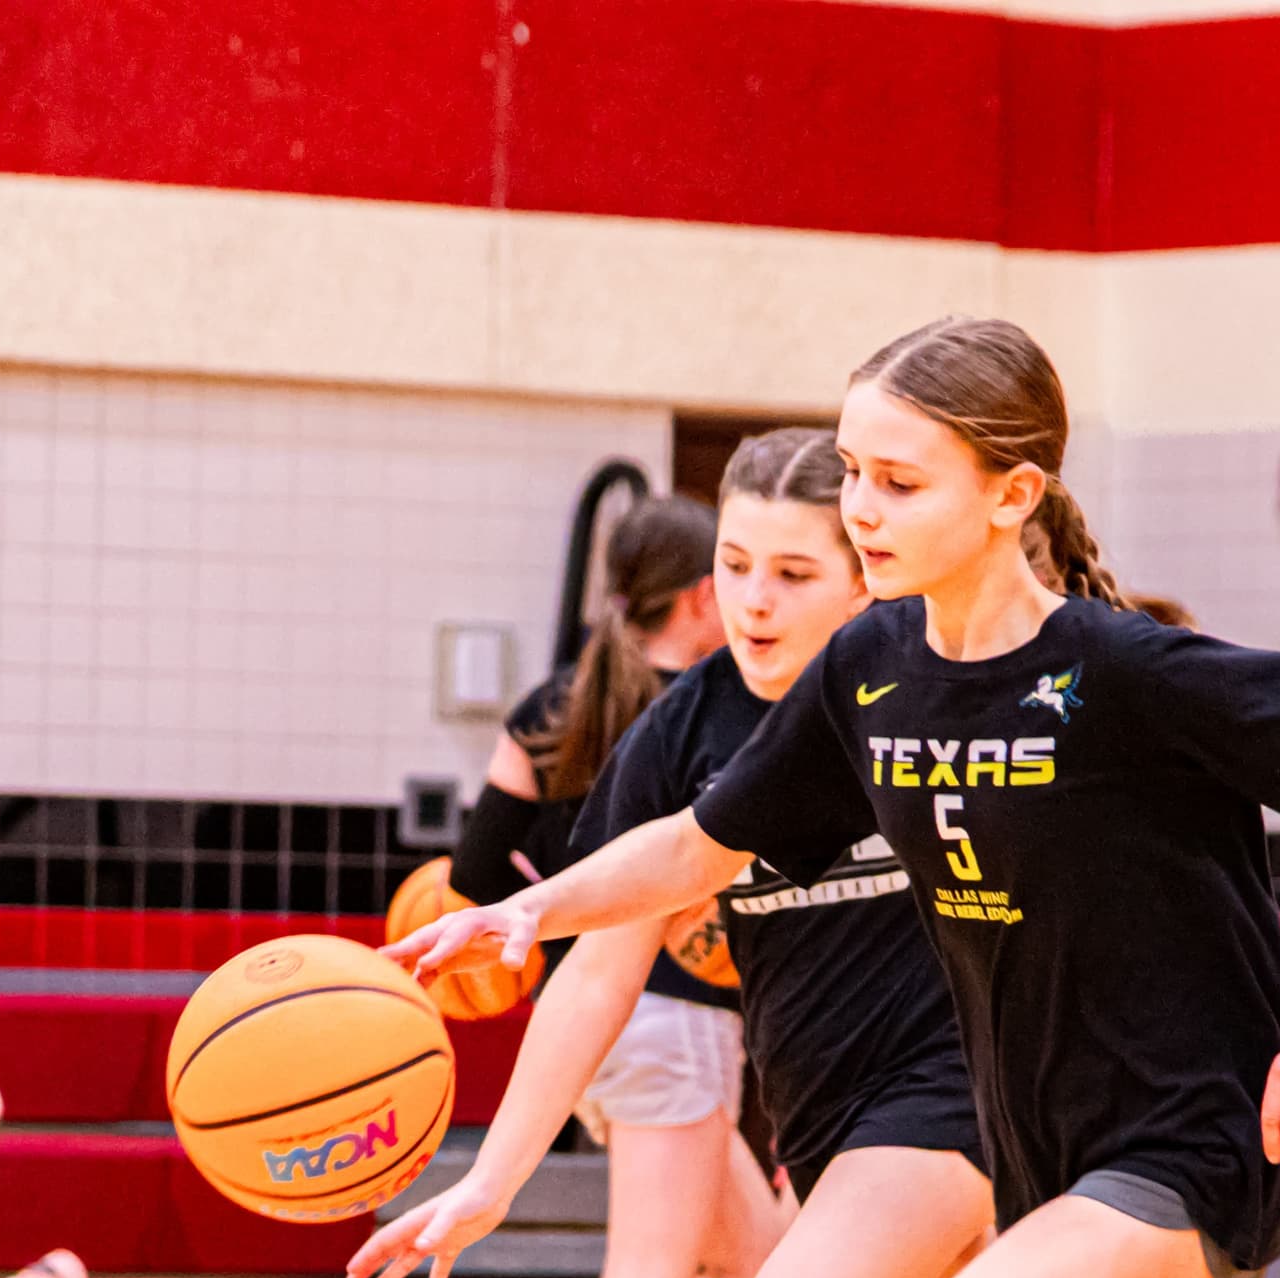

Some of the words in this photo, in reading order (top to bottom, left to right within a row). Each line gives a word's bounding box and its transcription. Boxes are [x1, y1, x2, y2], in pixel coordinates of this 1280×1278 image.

[868, 736, 1056, 788] TEXAS
[933, 794, 983, 882] 5
[978, 889, 1010, 907] WING
[263, 1110, 399, 1184] NCAA
